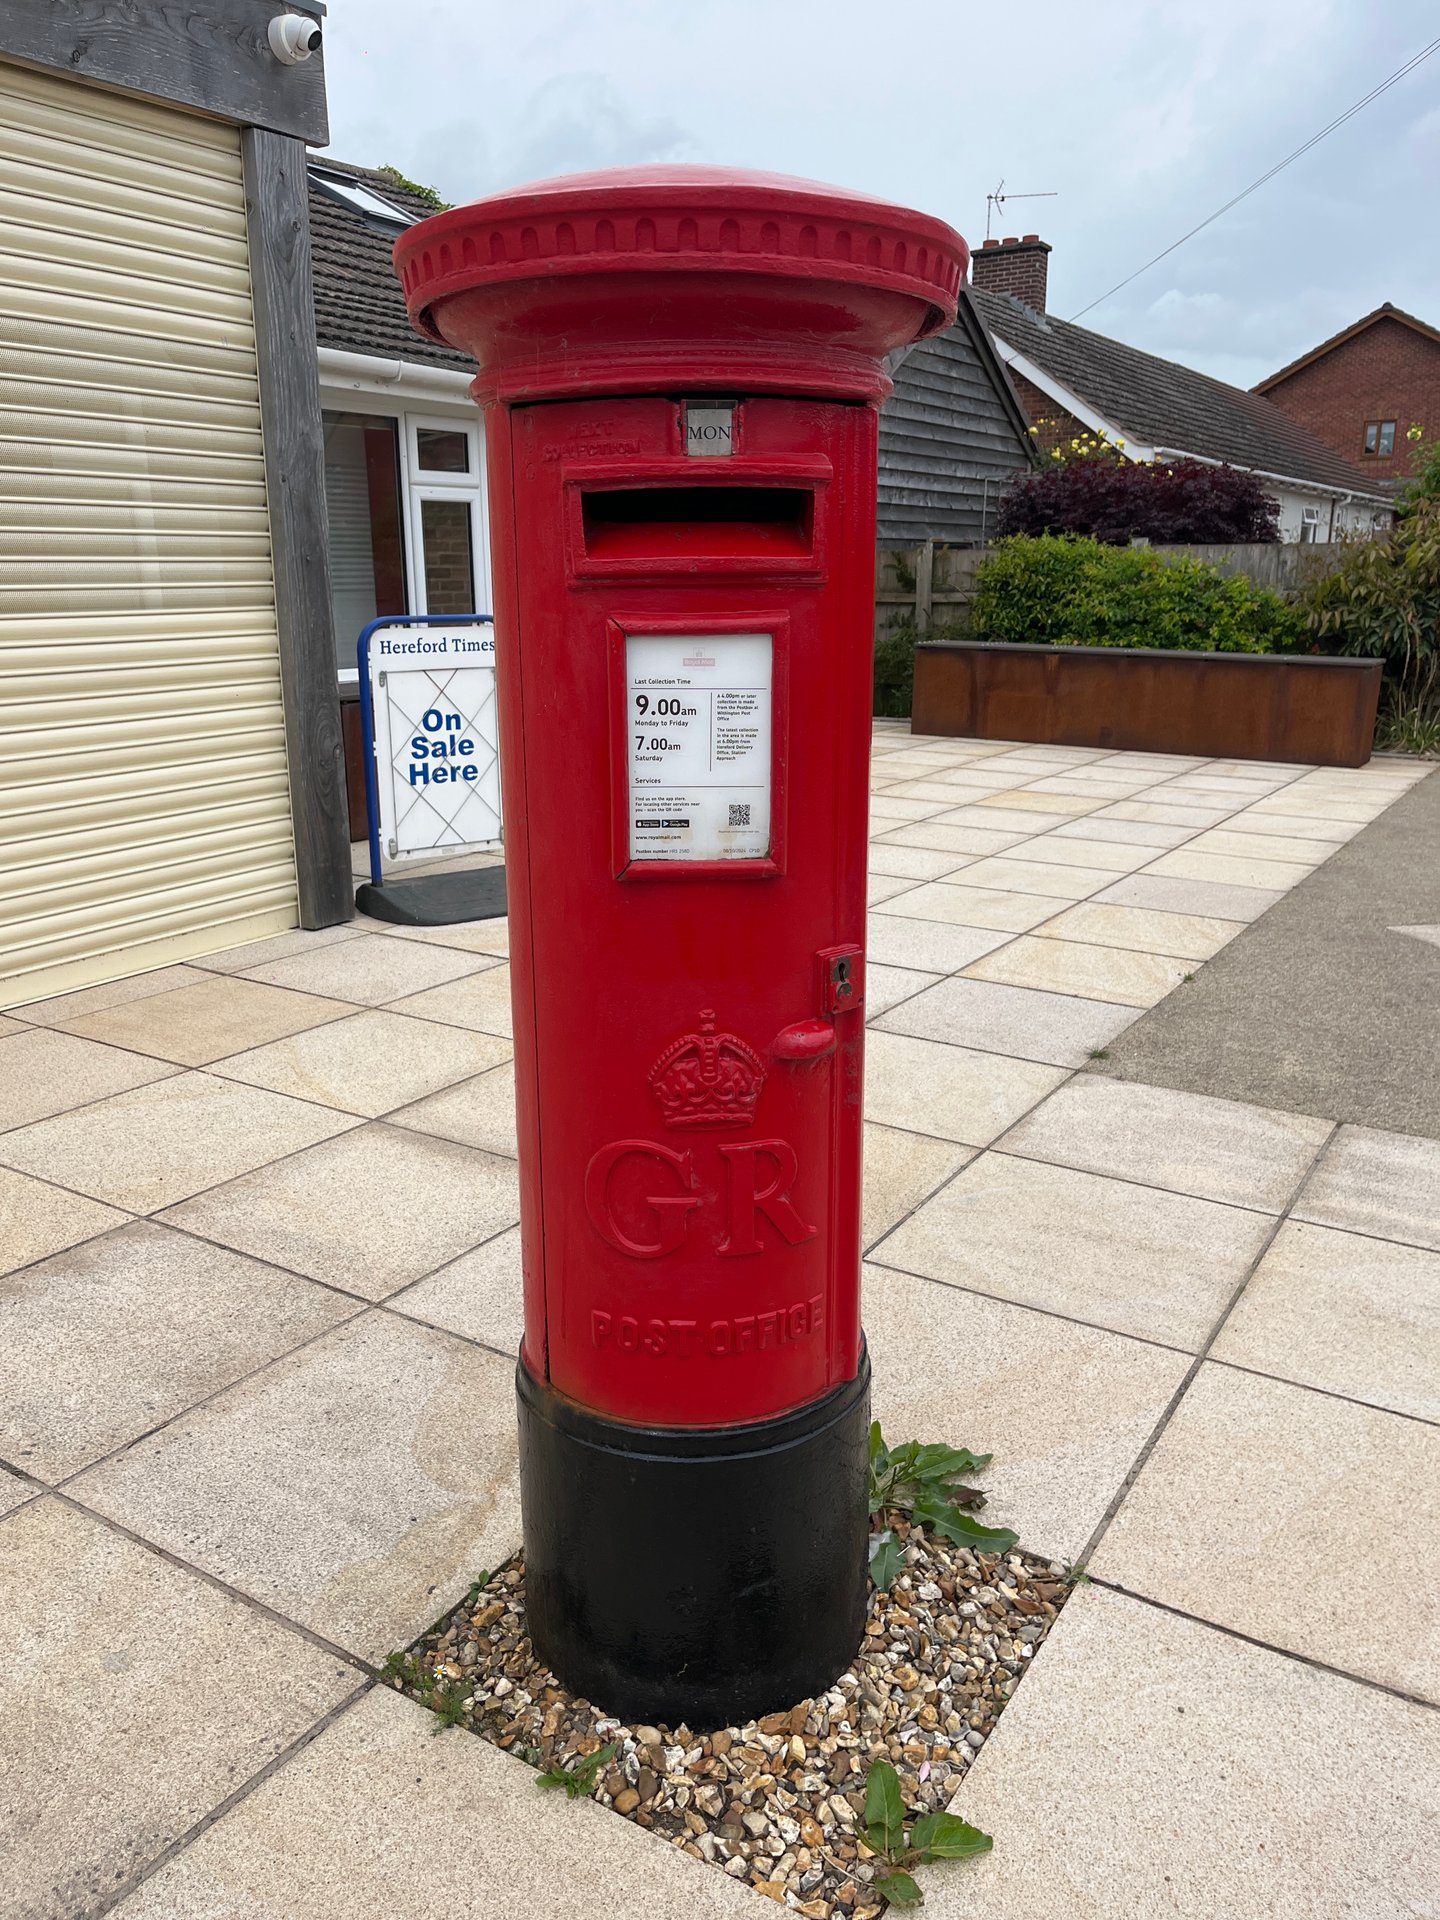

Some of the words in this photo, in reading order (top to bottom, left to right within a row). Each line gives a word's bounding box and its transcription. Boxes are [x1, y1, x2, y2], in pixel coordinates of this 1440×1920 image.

[688, 426, 731, 440] MON
[380, 637, 447, 654] Hereford
[452, 639, 495, 652] Times
[635, 694, 697, 716] 9.00am
[422, 709, 462, 732] On
[411, 734, 475, 759] Sale
[635, 736, 681, 751] 7.00am
[409, 762, 479, 785] Here
[584, 1138, 818, 1260] GR
[591, 1308, 698, 1357] POST
[704, 1293, 824, 1356] OFFICE
